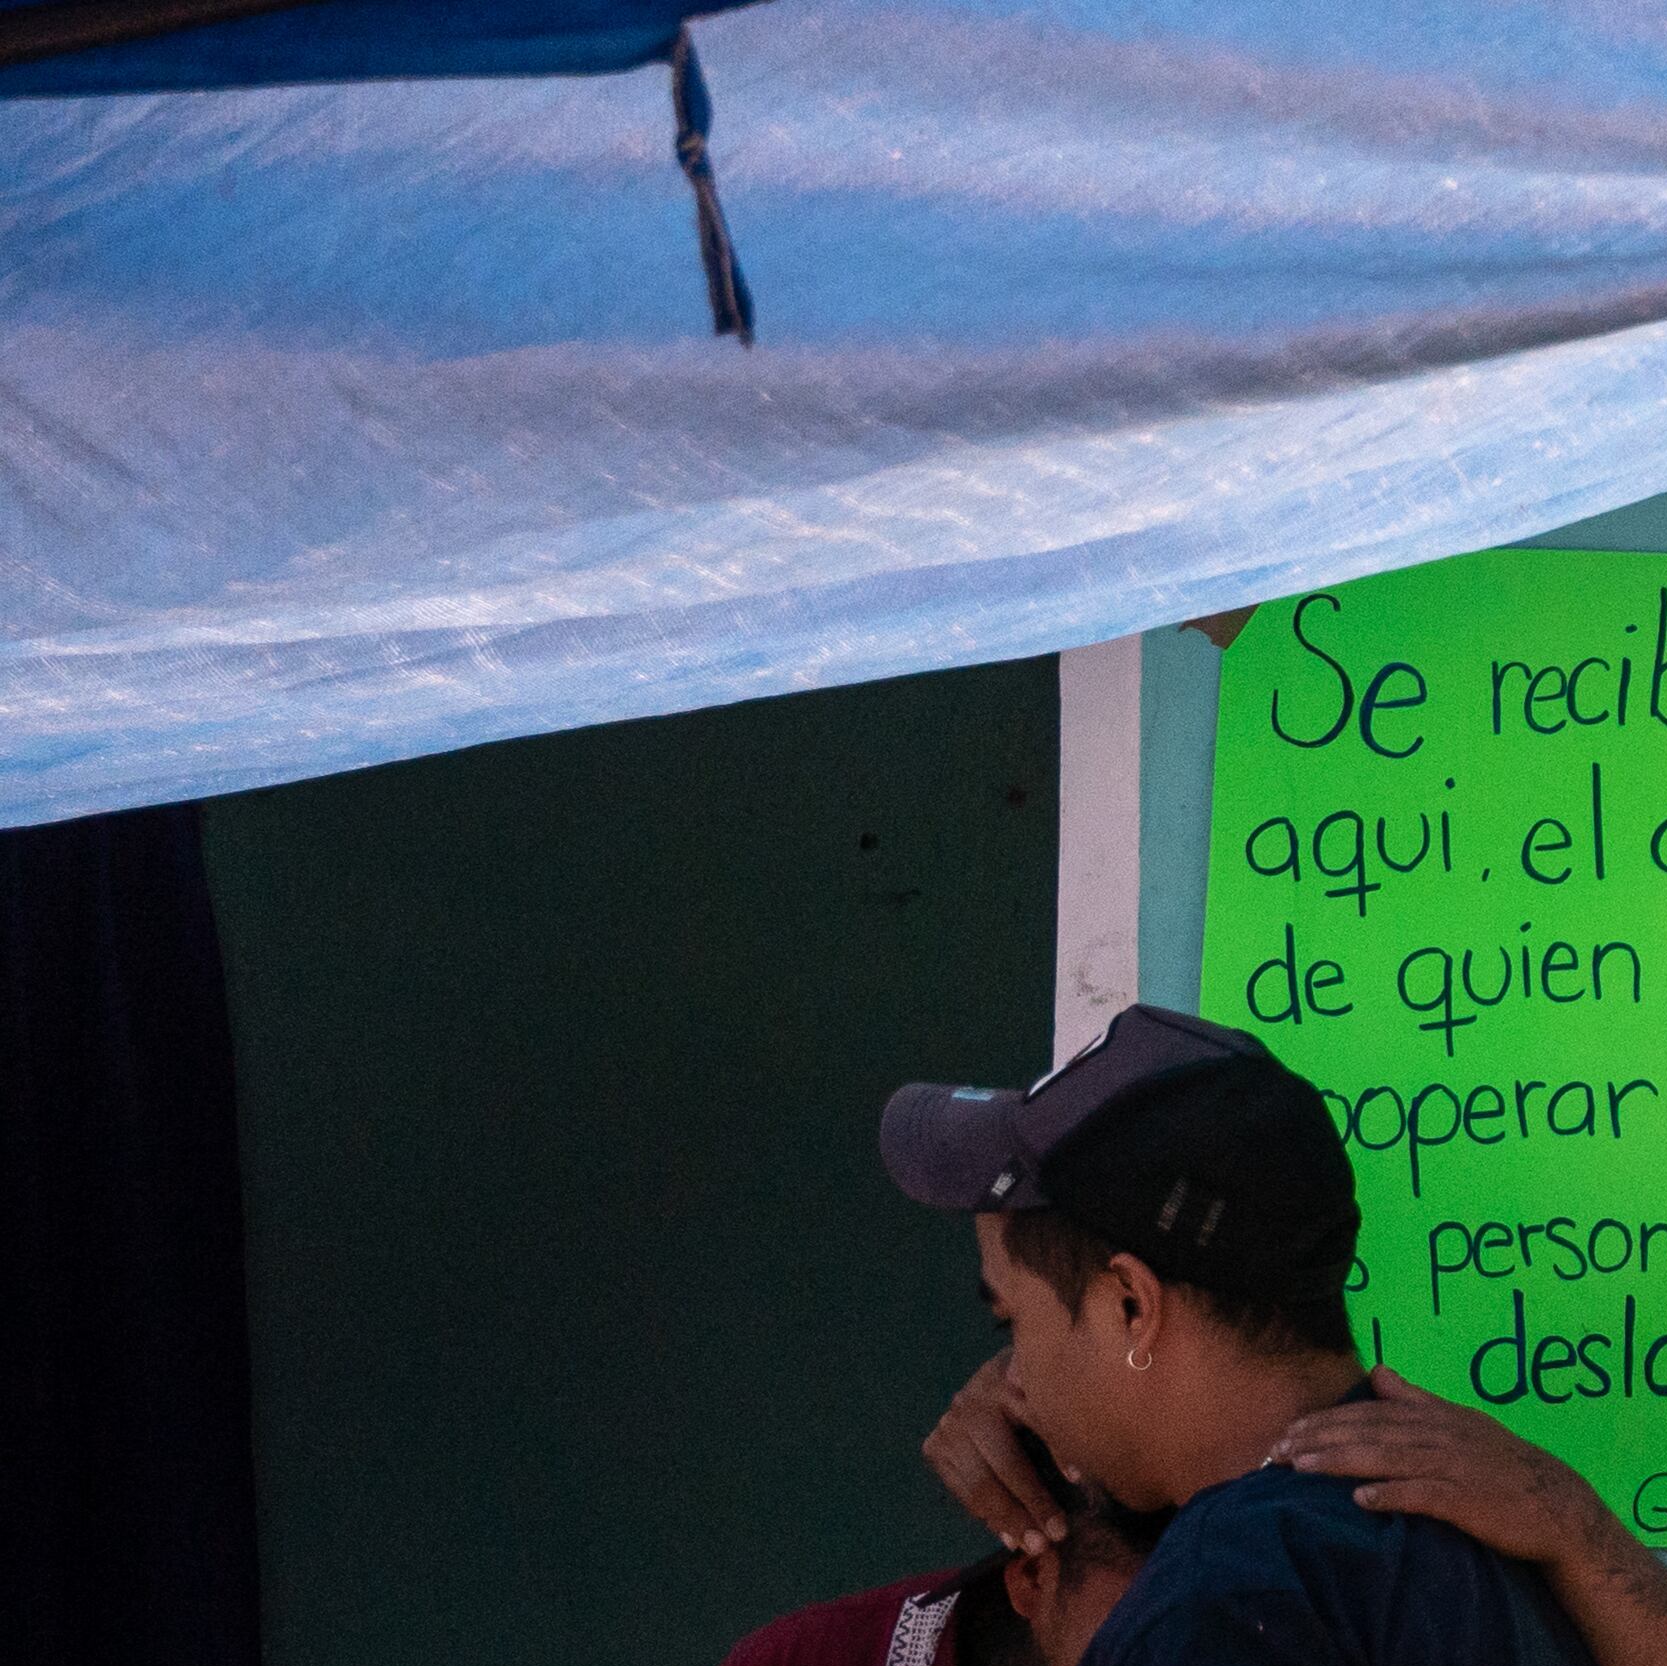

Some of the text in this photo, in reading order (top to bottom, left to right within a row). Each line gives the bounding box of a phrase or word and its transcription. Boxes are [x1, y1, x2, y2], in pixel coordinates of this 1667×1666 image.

[1271, 594, 1428, 758] Se
[1521, 763, 1603, 884] el
[1246, 923, 1353, 1024] de
[1398, 922, 1641, 1056] quien
